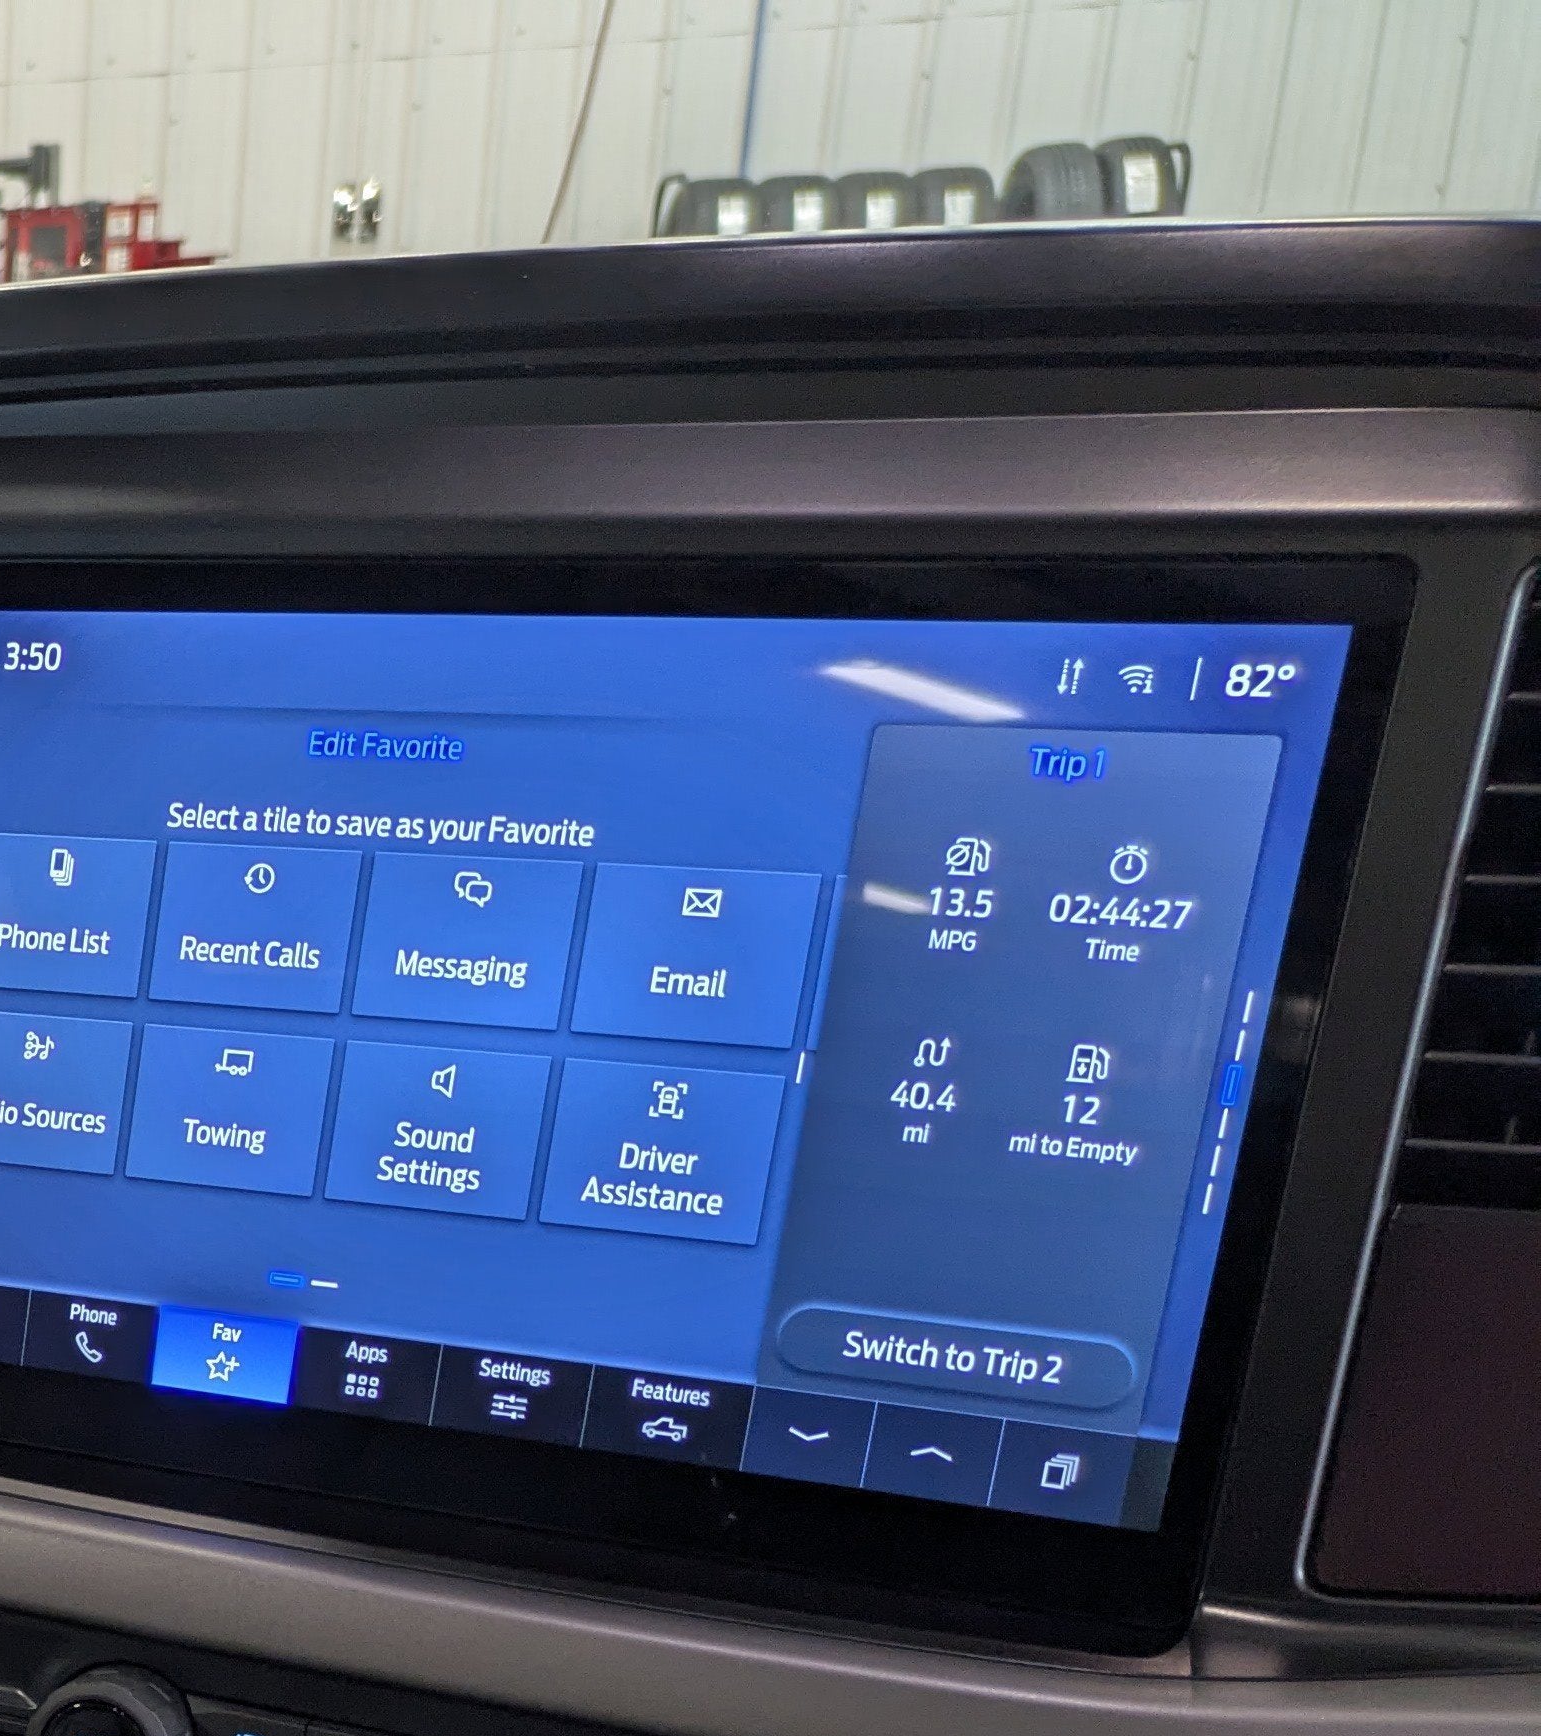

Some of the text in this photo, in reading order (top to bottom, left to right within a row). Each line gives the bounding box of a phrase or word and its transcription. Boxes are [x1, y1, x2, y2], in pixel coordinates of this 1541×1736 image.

[3, 642, 62, 673] 3:50
[308, 730, 464, 762] Edit Favorite
[1030, 748, 1106, 782] Trip 1
[166, 802, 595, 847] Select a tile to save as your Favorite
[928, 887, 992, 919] 13.5
[1049, 895, 1193, 931] 02:44:27
[68, 926, 111, 957] List
[180, 934, 321, 969] Recent Calls
[928, 929, 977, 953] MPG
[1086, 938, 1141, 963] Time
[395, 950, 528, 989] Messaging
[649, 967, 727, 1000] Email
[890, 1081, 957, 1112] 40.4
[1062, 1096, 1101, 1126] 12
[22, 1104, 107, 1136] Sources
[902, 1123, 930, 1145] mi
[183, 1119, 266, 1155] Towing
[395, 1122, 475, 1154] Sound
[1009, 1131, 1137, 1167] mi to Empty
[377, 1155, 481, 1193] Settings
[619, 1143, 700, 1178] Driver
[581, 1177, 723, 1217] Assistance
[70, 1303, 118, 1327] Phone
[212, 1323, 242, 1344] Fav
[345, 1340, 388, 1366] Apps
[842, 1330, 1062, 1384] Switch to Trip 2
[478, 1358, 551, 1386] Settings
[631, 1379, 710, 1407] Features
